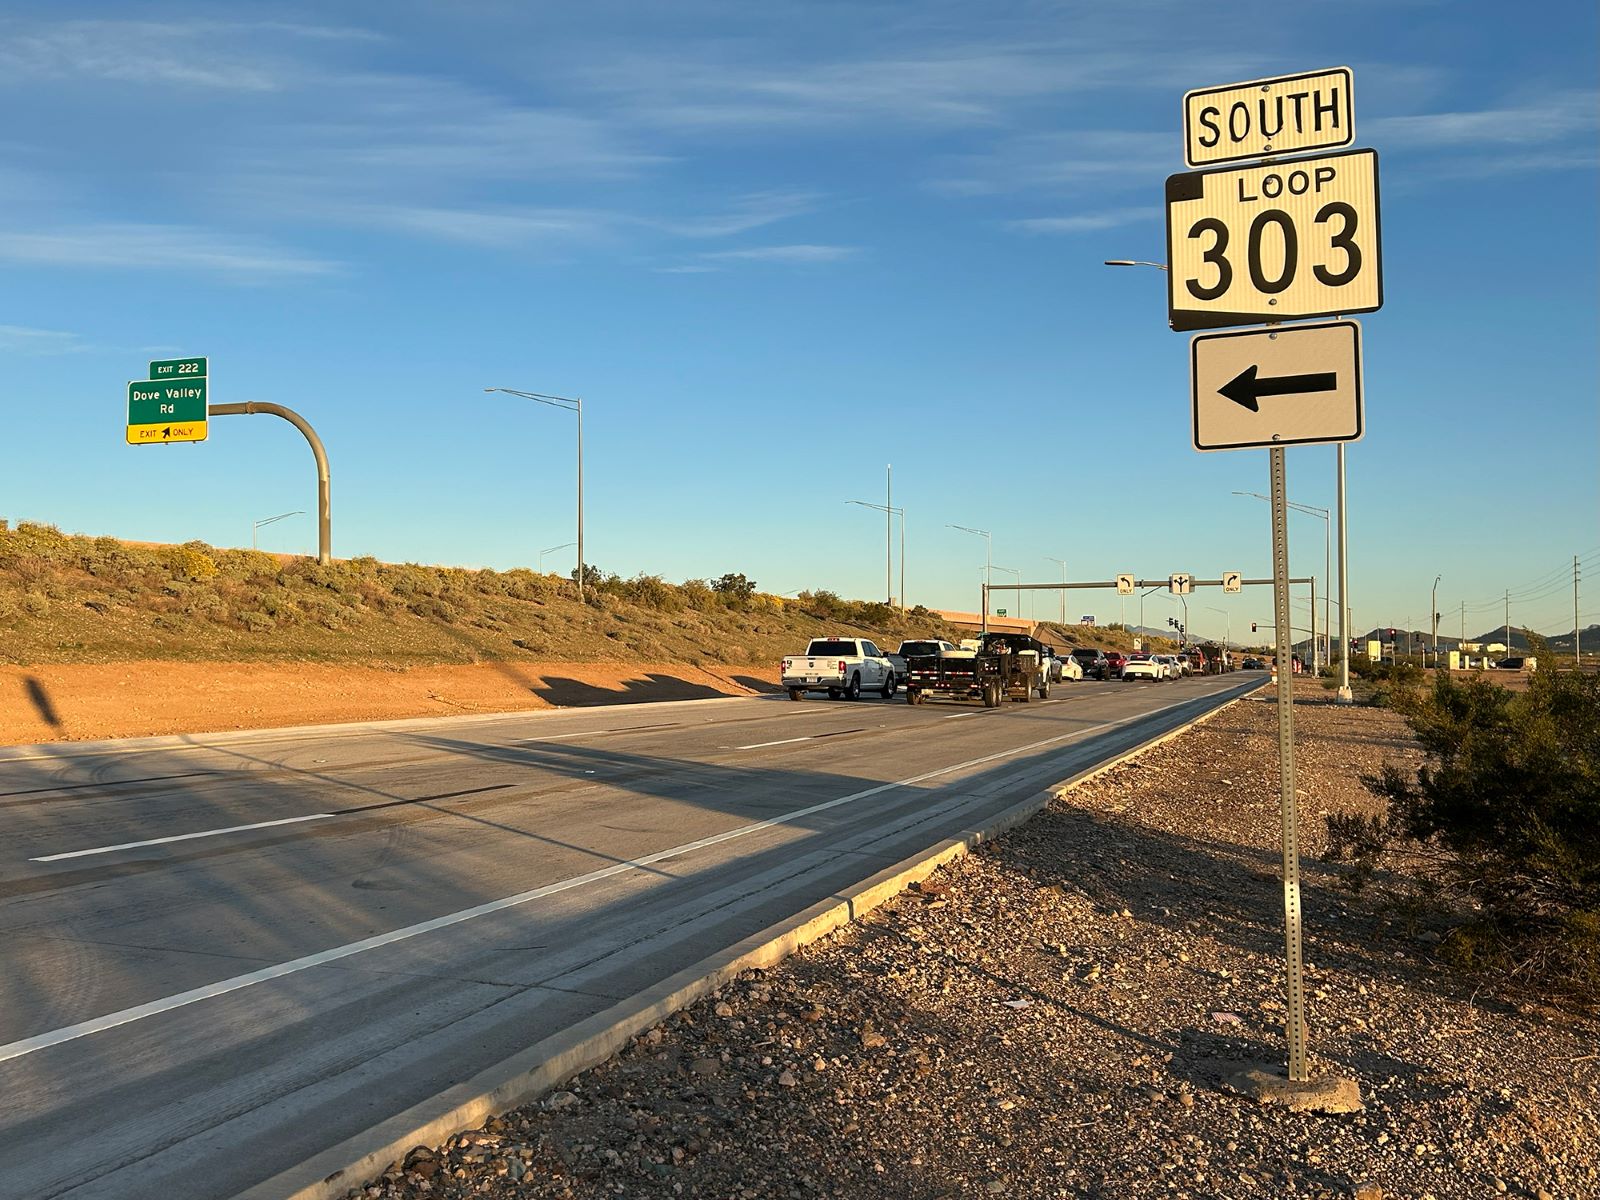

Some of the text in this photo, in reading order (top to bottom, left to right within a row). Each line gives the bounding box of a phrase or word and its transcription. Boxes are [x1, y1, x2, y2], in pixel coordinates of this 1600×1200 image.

[1198, 87, 1340, 147] SOUTH
[1238, 166, 1336, 202] LOOP
[1185, 201, 1362, 301] 303
[157, 363, 199, 374] EXIT 222
[133, 389, 202, 401] Dove Valley
[160, 404, 174, 414] Rd
[140, 428, 194, 438] EXIT ONLY
